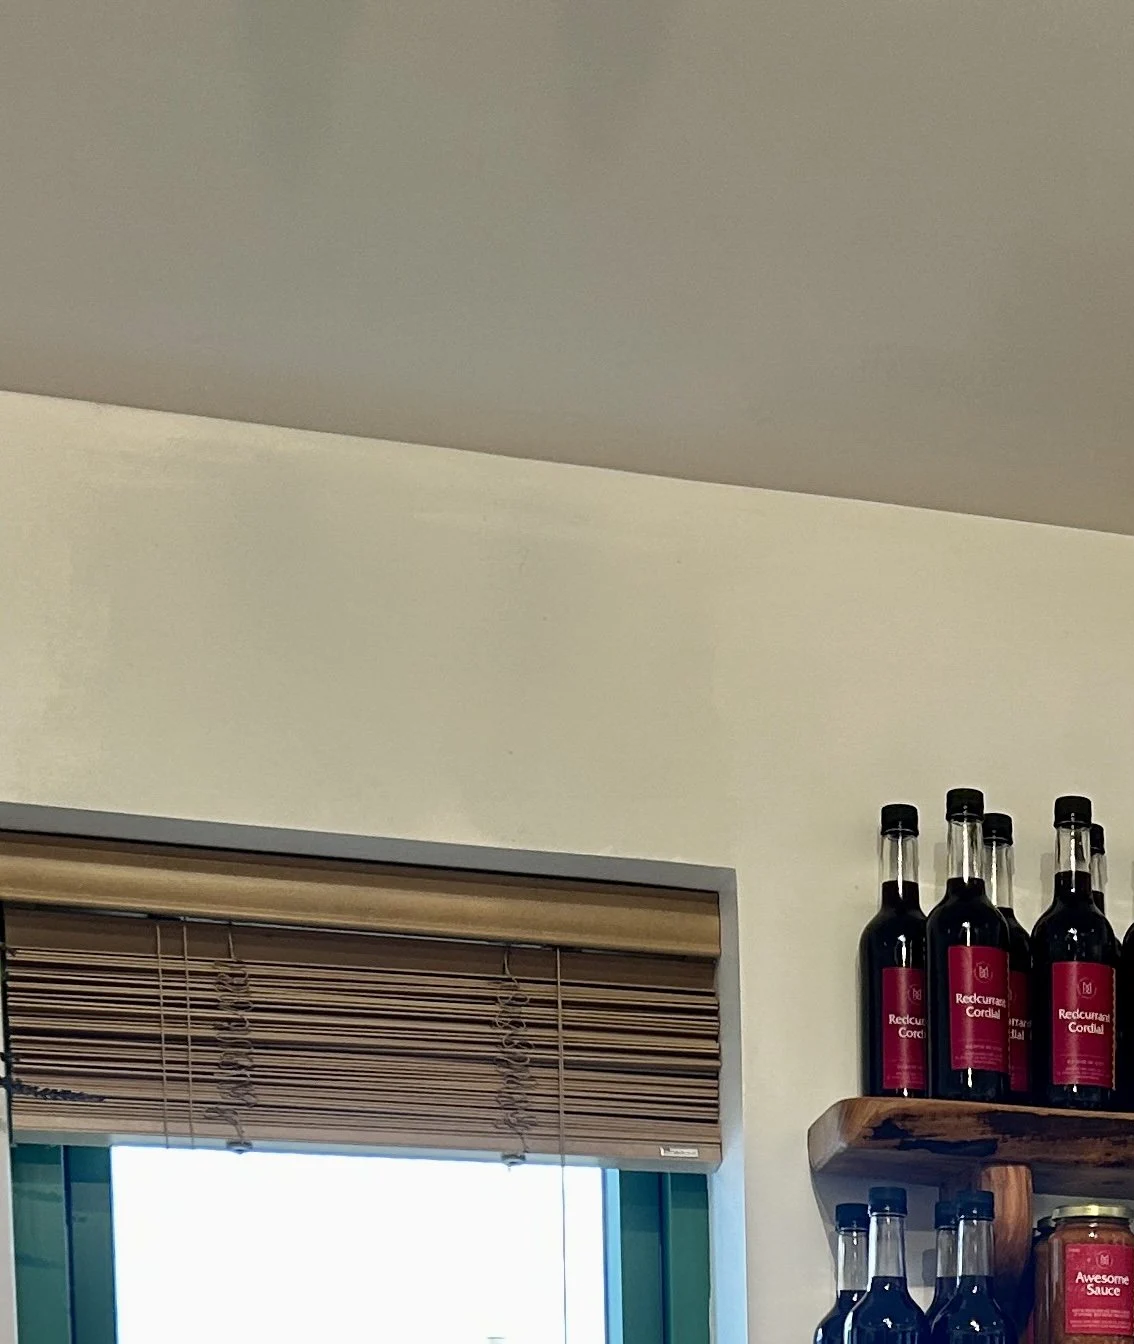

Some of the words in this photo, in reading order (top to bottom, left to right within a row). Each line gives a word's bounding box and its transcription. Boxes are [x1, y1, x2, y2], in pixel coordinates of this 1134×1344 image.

[955, 993, 1006, 1008] Redcurrant
[965, 1006, 1001, 1020] Cordial
[1058, 1008, 1111, 1024] Redcurrant
[1068, 1022, 1104, 1035] Cordial
[1075, 1272, 1129, 1285] Awesome
[1086, 1284, 1121, 1297] Sauce
